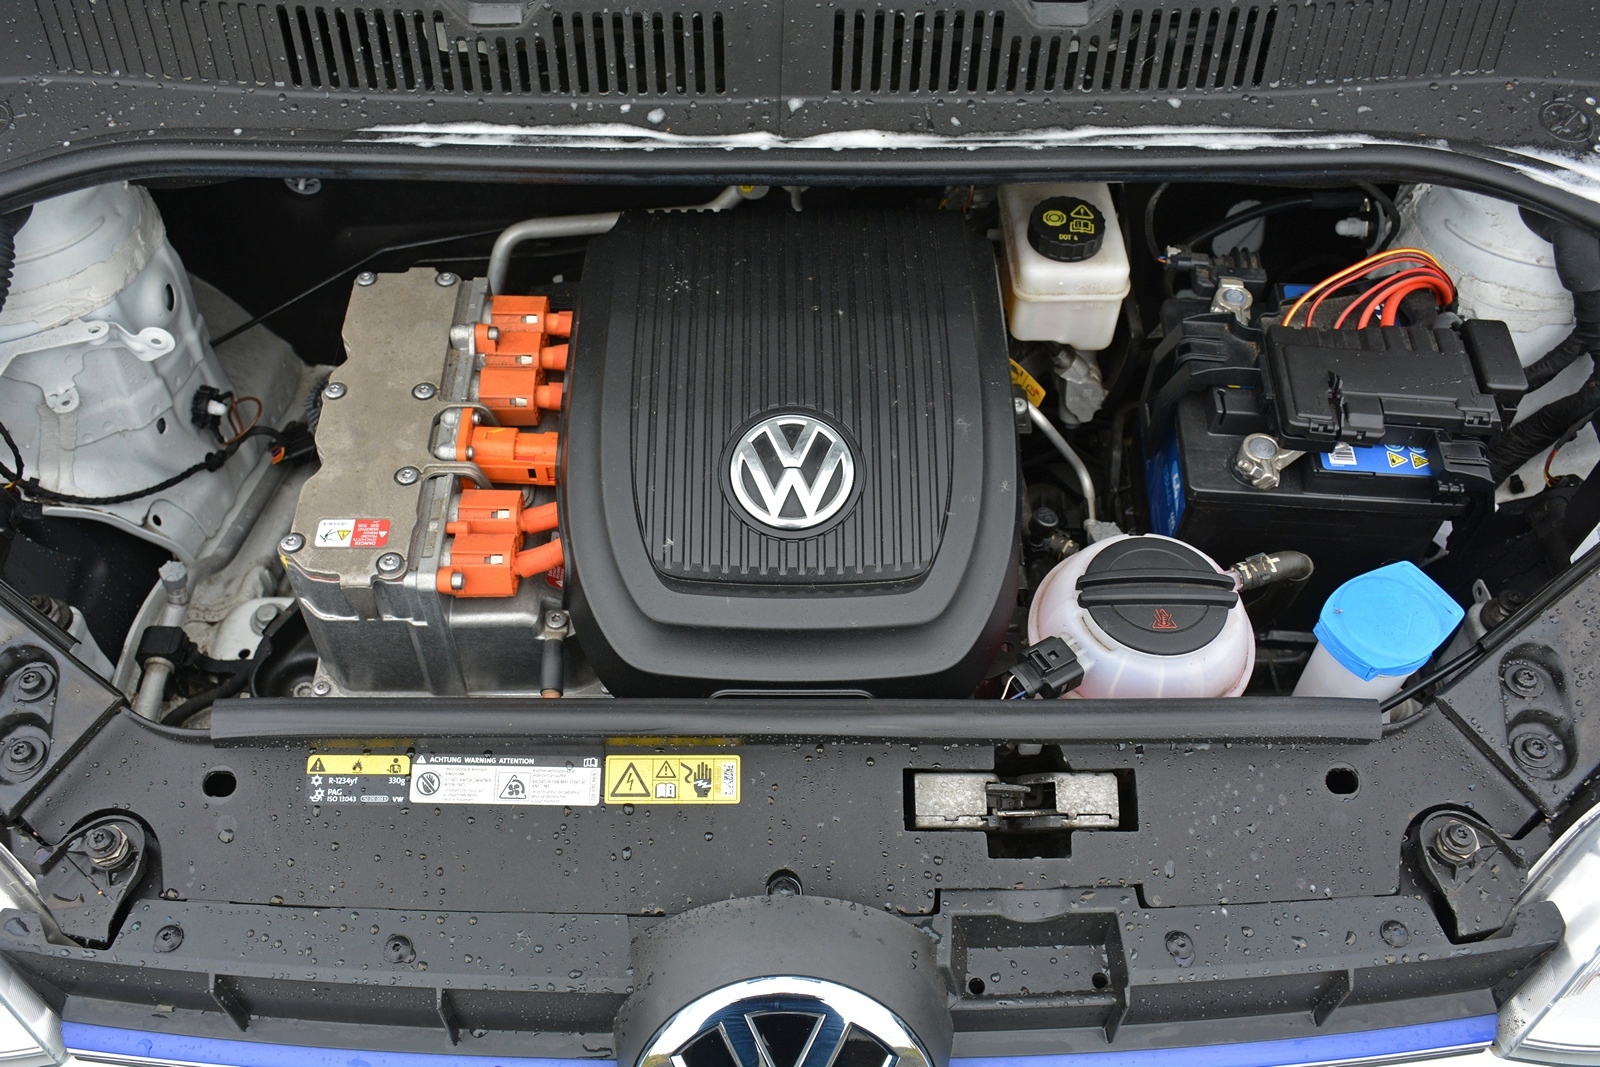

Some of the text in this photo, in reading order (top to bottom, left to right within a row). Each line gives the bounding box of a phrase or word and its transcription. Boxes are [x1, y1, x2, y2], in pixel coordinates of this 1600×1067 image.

[1058, 233, 1071, 241] DOT
[731, 414, 855, 530] VW
[429, 756, 462, 764] ACHTUNG
[328, 776, 406, 787] R-1234yf 330g
[327, 788, 343, 796] PAG
[636, 975, 936, 1067] V
